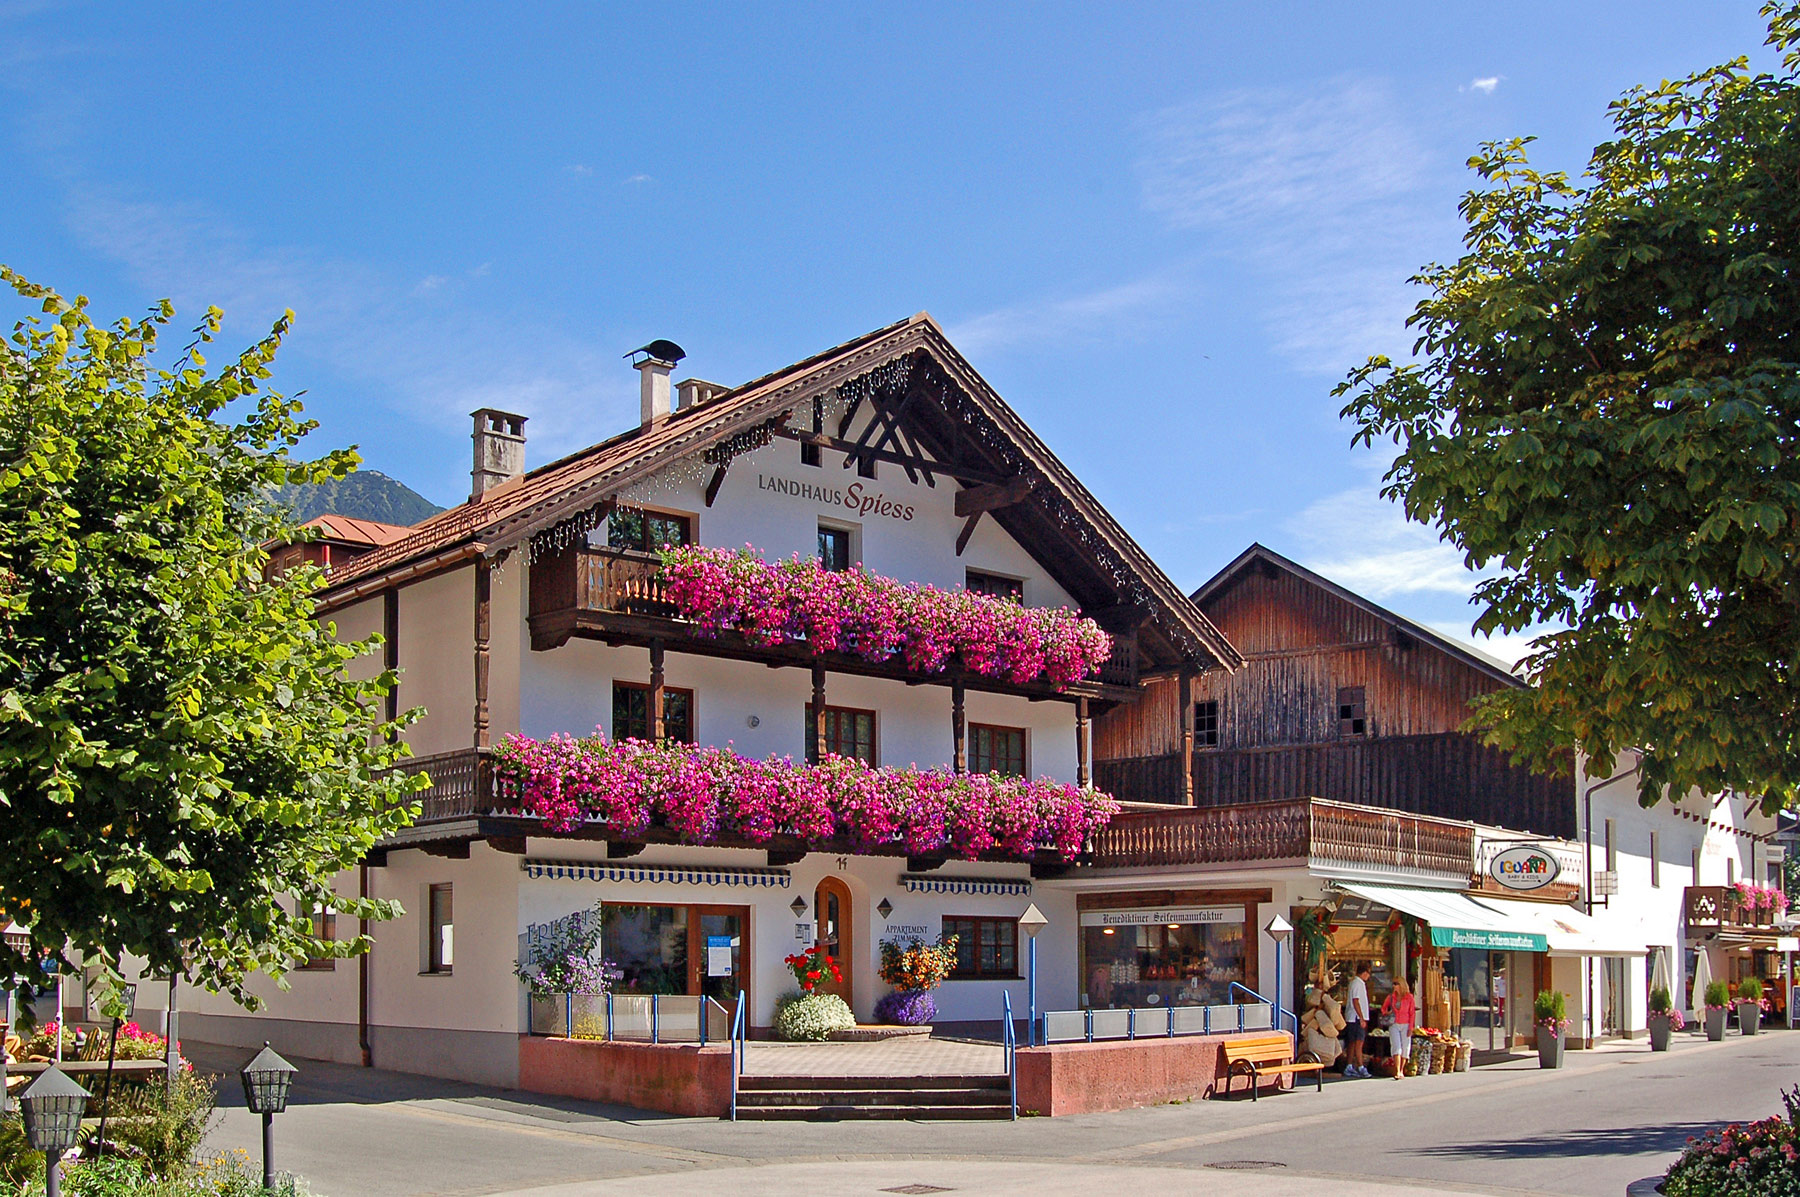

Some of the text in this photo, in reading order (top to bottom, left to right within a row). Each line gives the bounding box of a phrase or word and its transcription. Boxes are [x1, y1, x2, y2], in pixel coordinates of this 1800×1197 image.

[758, 474, 914, 521] LANDHAUS Spiess
[1500, 860, 1547, 873] IGUANA
[1103, 913, 1149, 924] Benediktiner
